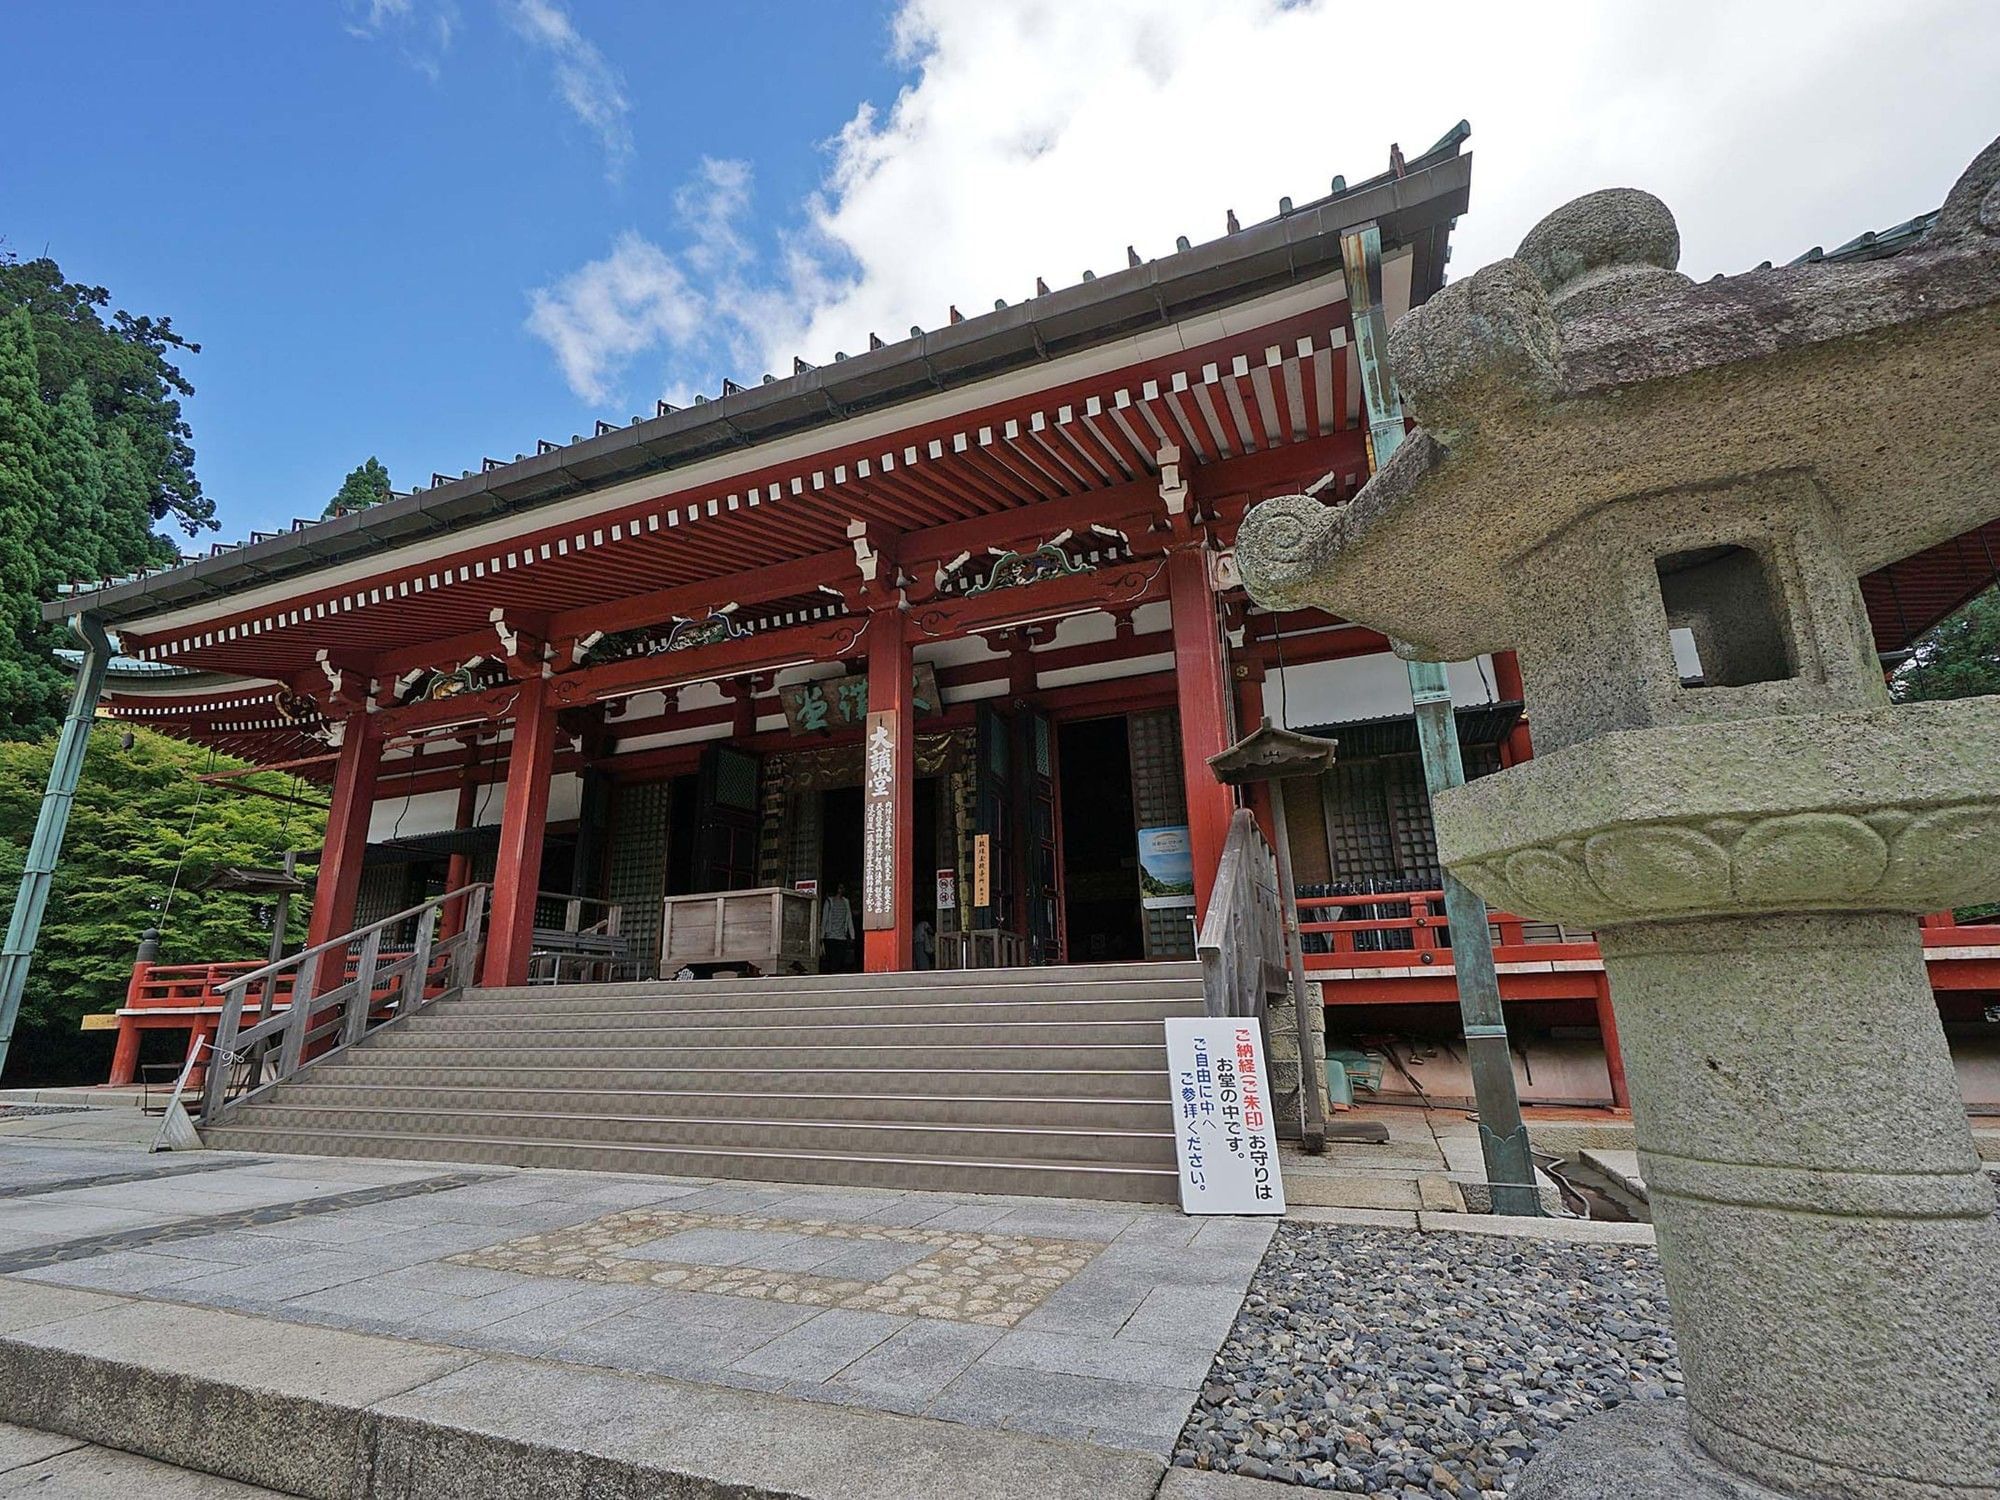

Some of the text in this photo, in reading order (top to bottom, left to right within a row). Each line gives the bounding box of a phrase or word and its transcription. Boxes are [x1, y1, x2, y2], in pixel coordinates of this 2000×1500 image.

[868, 726, 895, 797] 大講堂
[1180, 1072, 1206, 1191] ご参拝ください。
[1194, 1037, 1217, 1130] ご自由に中へ
[1216, 1058, 1245, 1160] お堂の中です。
[1235, 1028, 1273, 1200] ご納経（ご朱印）お守りは
